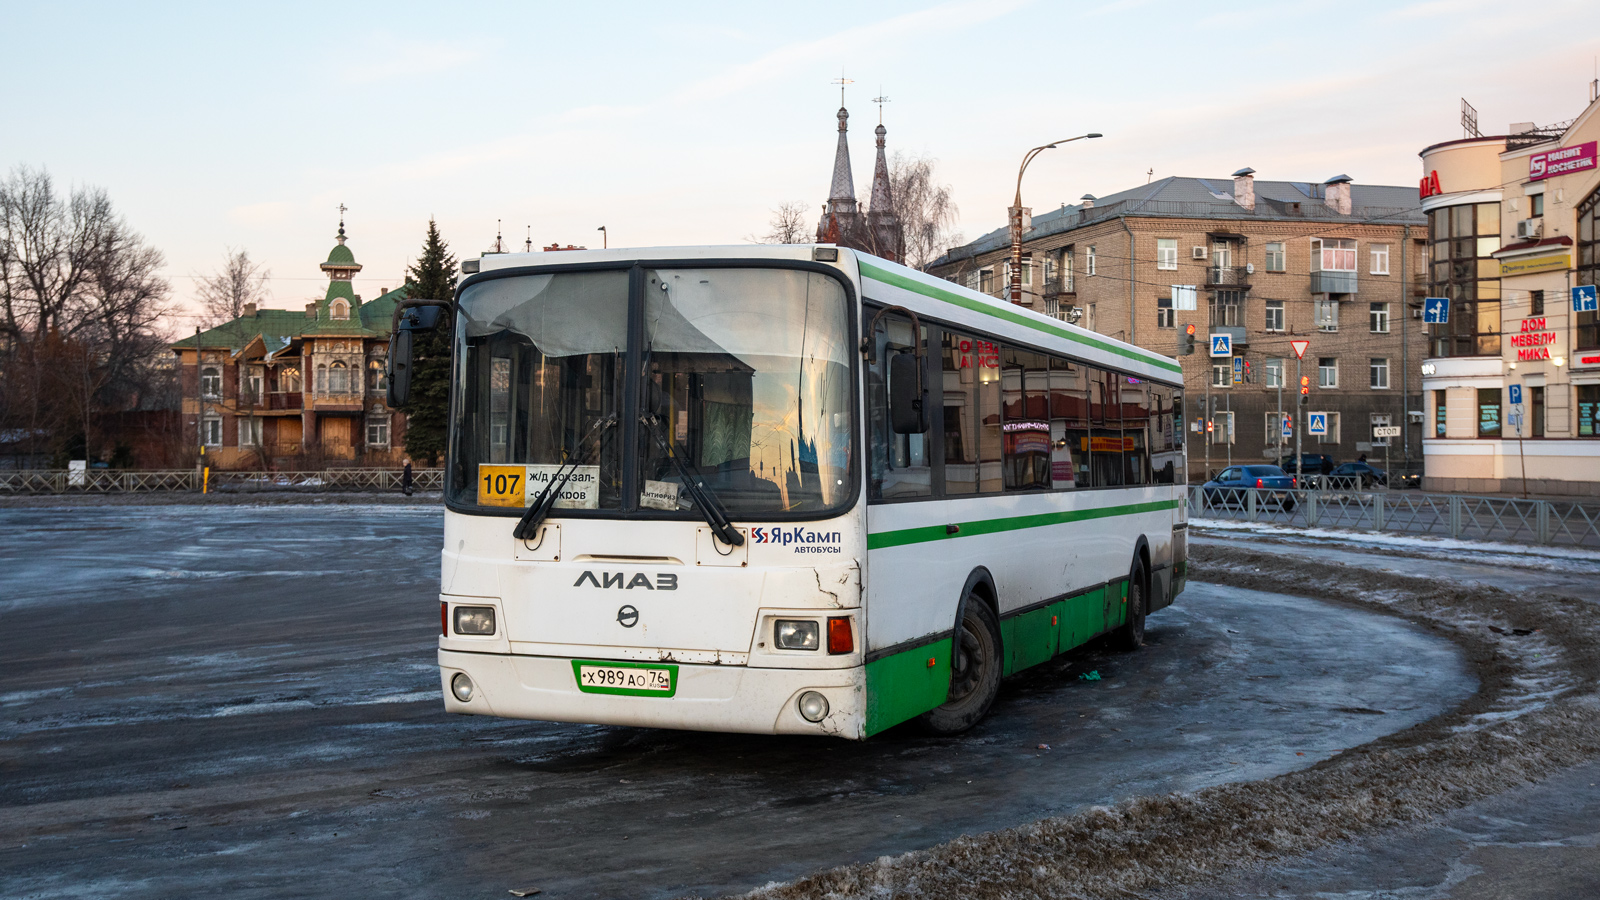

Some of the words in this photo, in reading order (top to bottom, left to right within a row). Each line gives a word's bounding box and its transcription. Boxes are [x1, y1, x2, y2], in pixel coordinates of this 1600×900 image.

[1548, 147, 1582, 162] МАГНИТ
[1521, 317, 1546, 333] ДОМ
[1511, 332, 1556, 347] МЕБЕЛИ
[1518, 347, 1551, 360] МИКА
[484, 474, 520, 494] 107
[529, 471, 548, 482] ж/д
[771, 527, 841, 546] ЯрКамп
[794, 546, 841, 554] АВТОБУСЫ
[573, 571, 678, 591] ЛИАЗ
